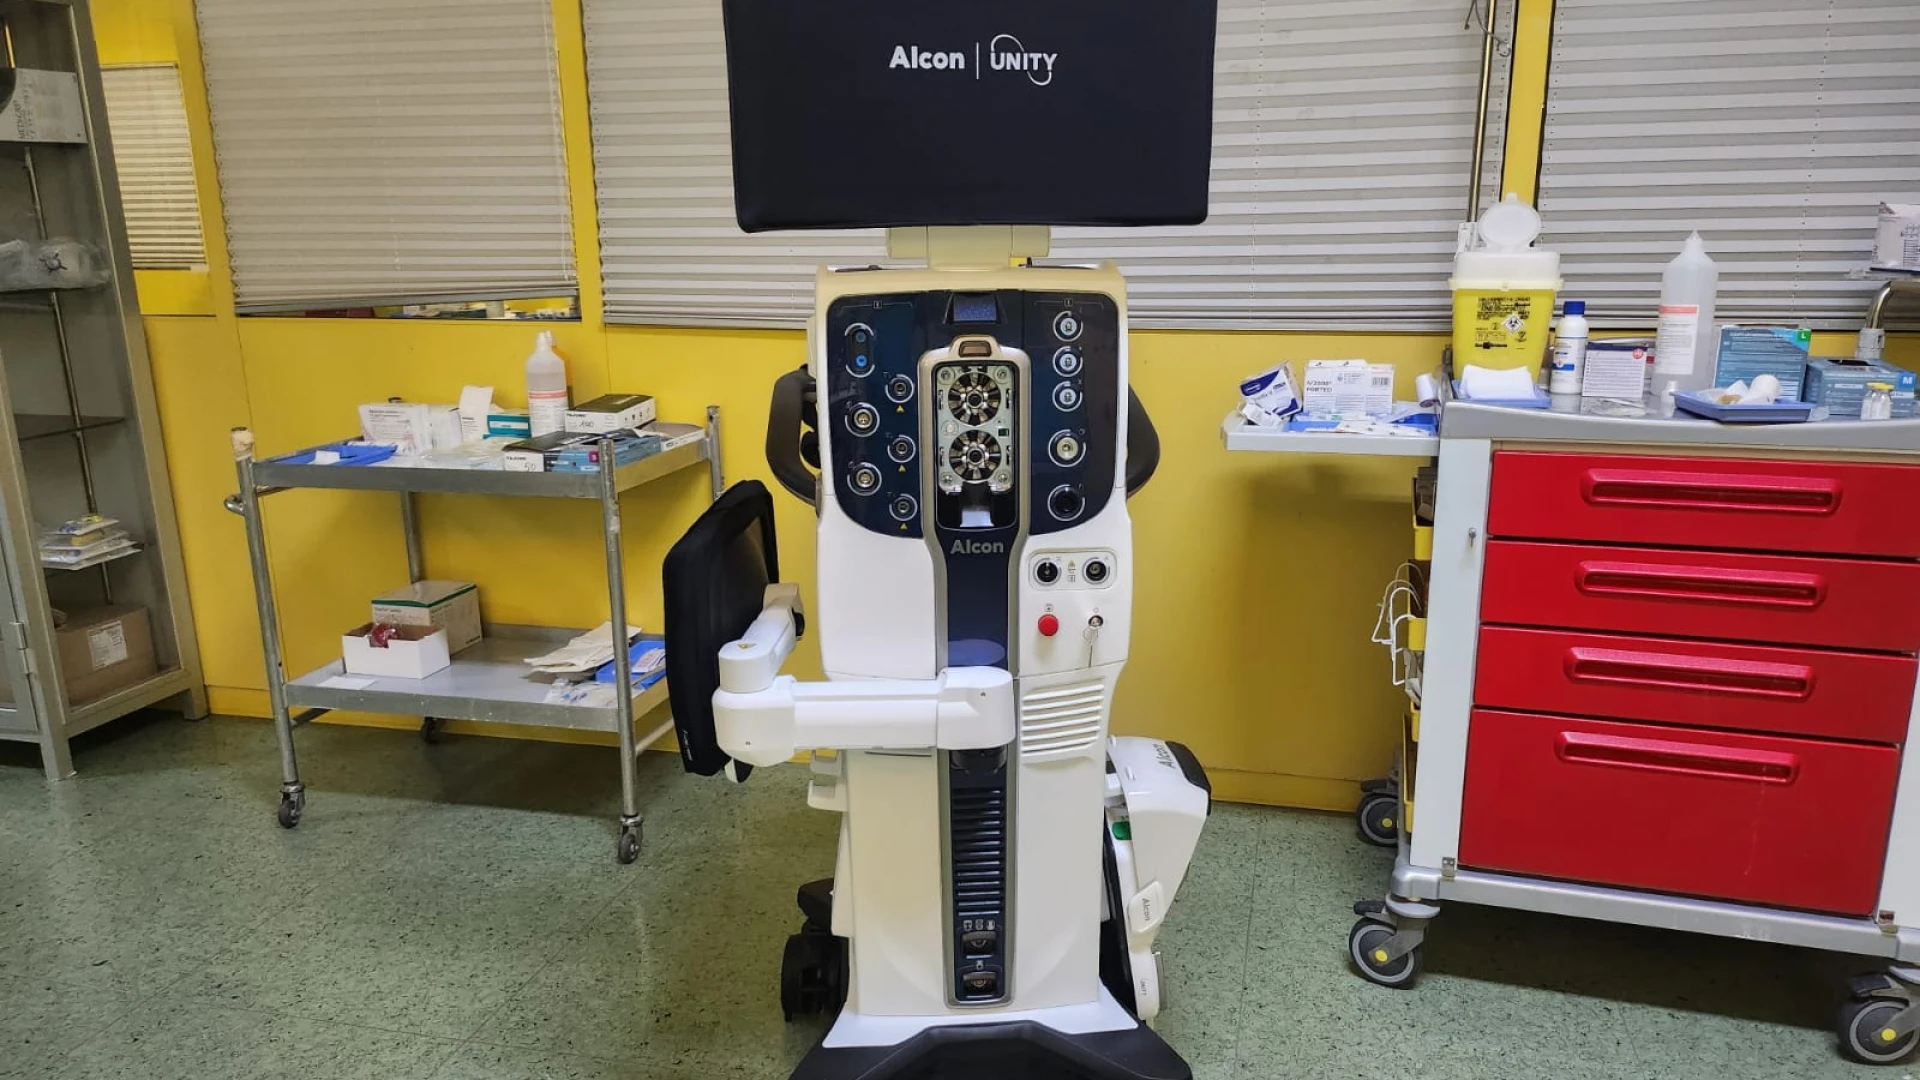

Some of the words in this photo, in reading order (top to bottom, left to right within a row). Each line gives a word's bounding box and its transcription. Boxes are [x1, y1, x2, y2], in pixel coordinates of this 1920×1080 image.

[889, 45, 965, 70] Alcon
[990, 53, 1058, 71] UNITY
[1902, 376, 1913, 385] M
[950, 539, 1004, 554] Alcon
[1142, 898, 1151, 921] Alcon
